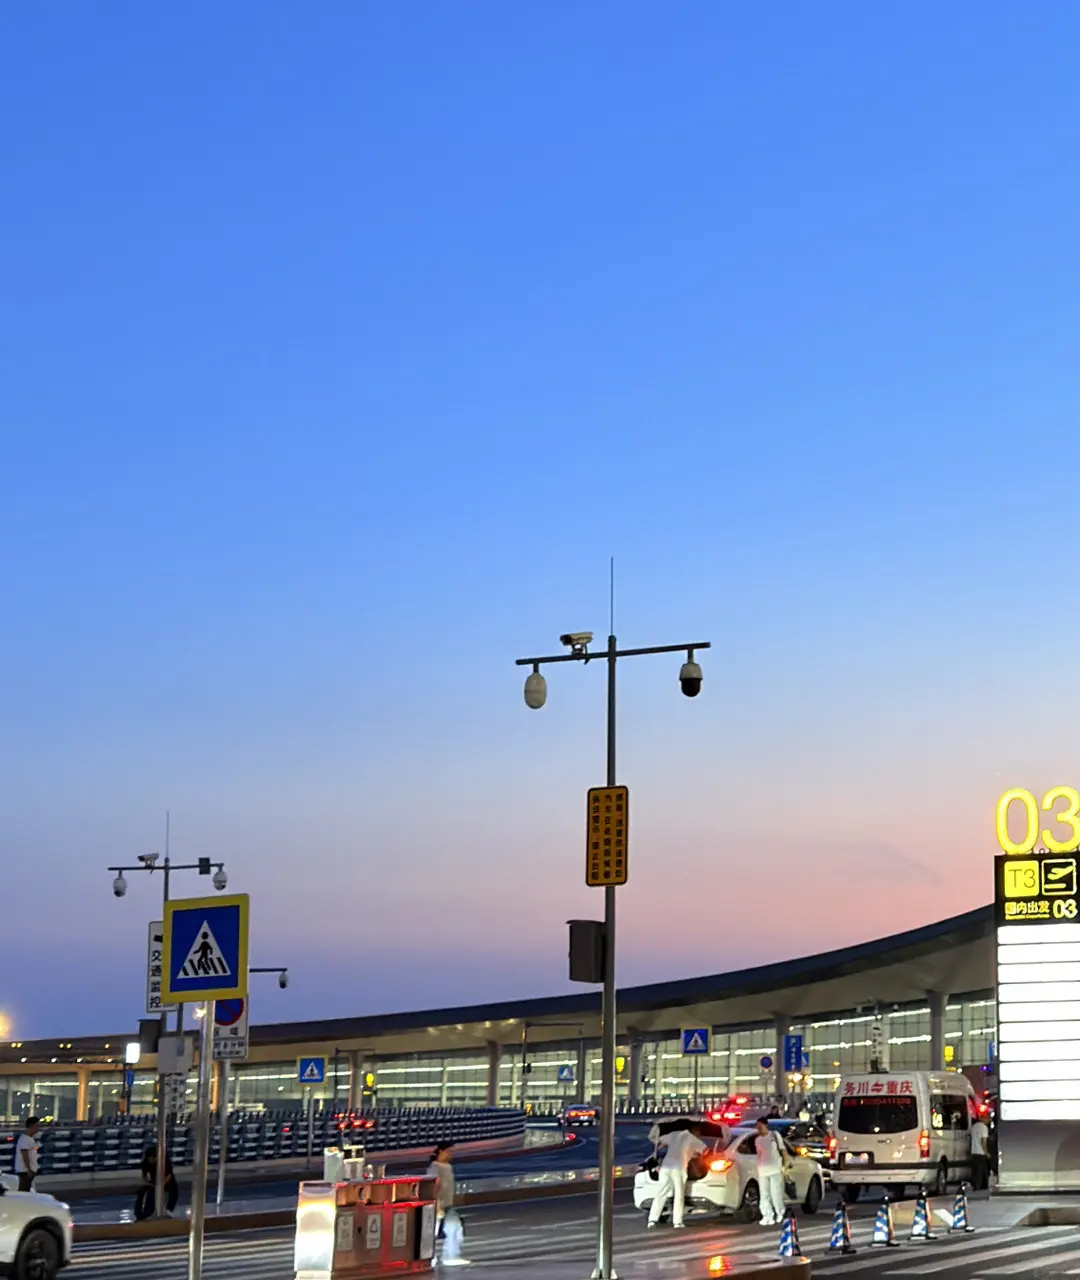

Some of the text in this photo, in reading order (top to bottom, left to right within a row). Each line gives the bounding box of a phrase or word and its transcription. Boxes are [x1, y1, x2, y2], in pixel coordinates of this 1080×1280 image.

[1008, 868, 1036, 889] T3
[1004, 899, 1078, 919] 国内出发 03
[844, 1081, 913, 1096] 务川 重庆
